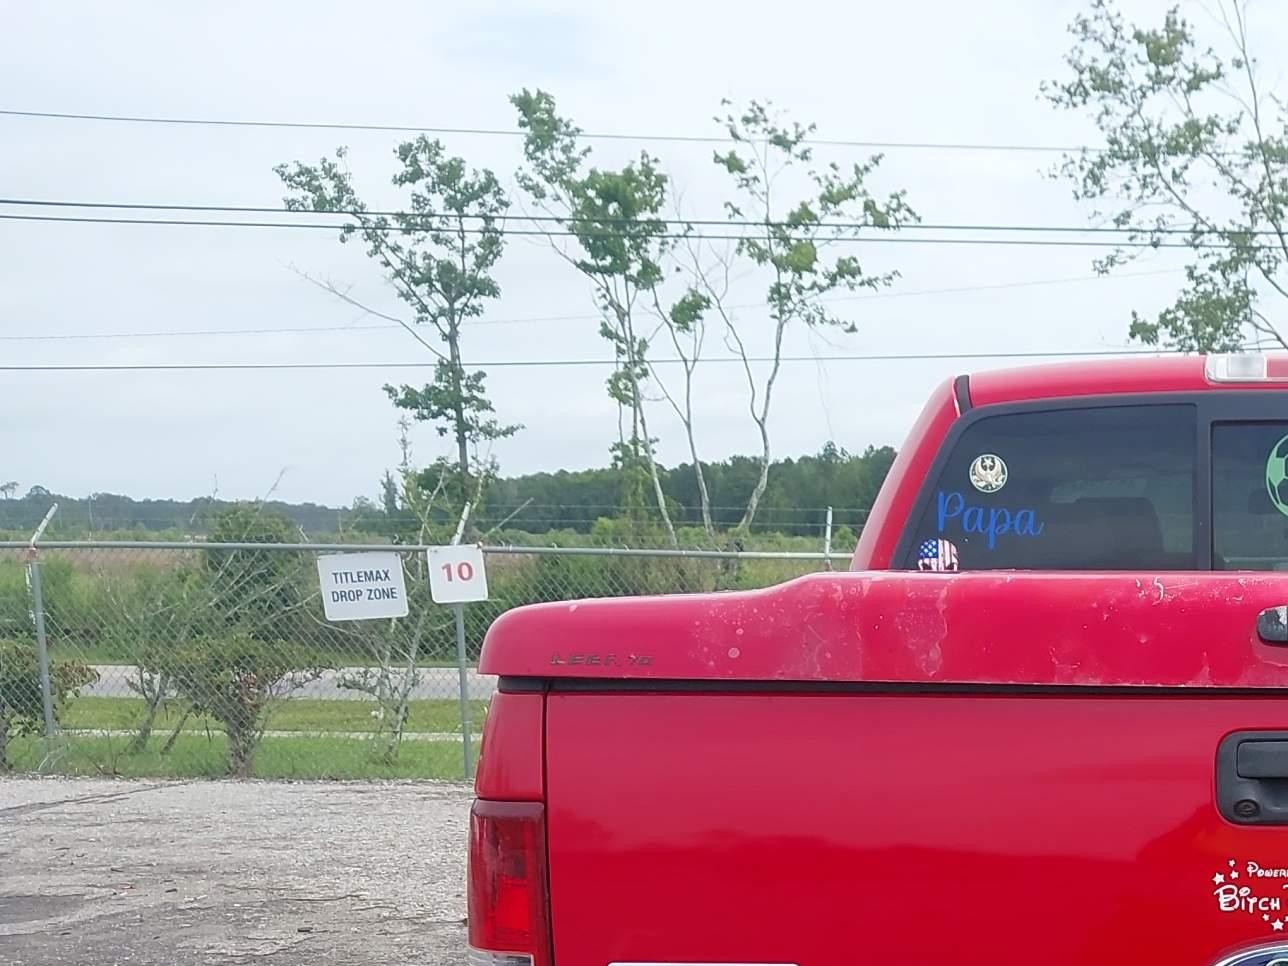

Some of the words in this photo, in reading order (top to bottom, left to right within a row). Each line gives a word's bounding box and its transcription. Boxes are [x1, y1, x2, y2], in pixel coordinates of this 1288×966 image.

[936, 491, 1045, 551] Papa
[332, 569, 391, 585] TITLEMAX
[441, 562, 473, 582] 10
[331, 589, 363, 603] DROP
[366, 587, 398, 601] ZONE
